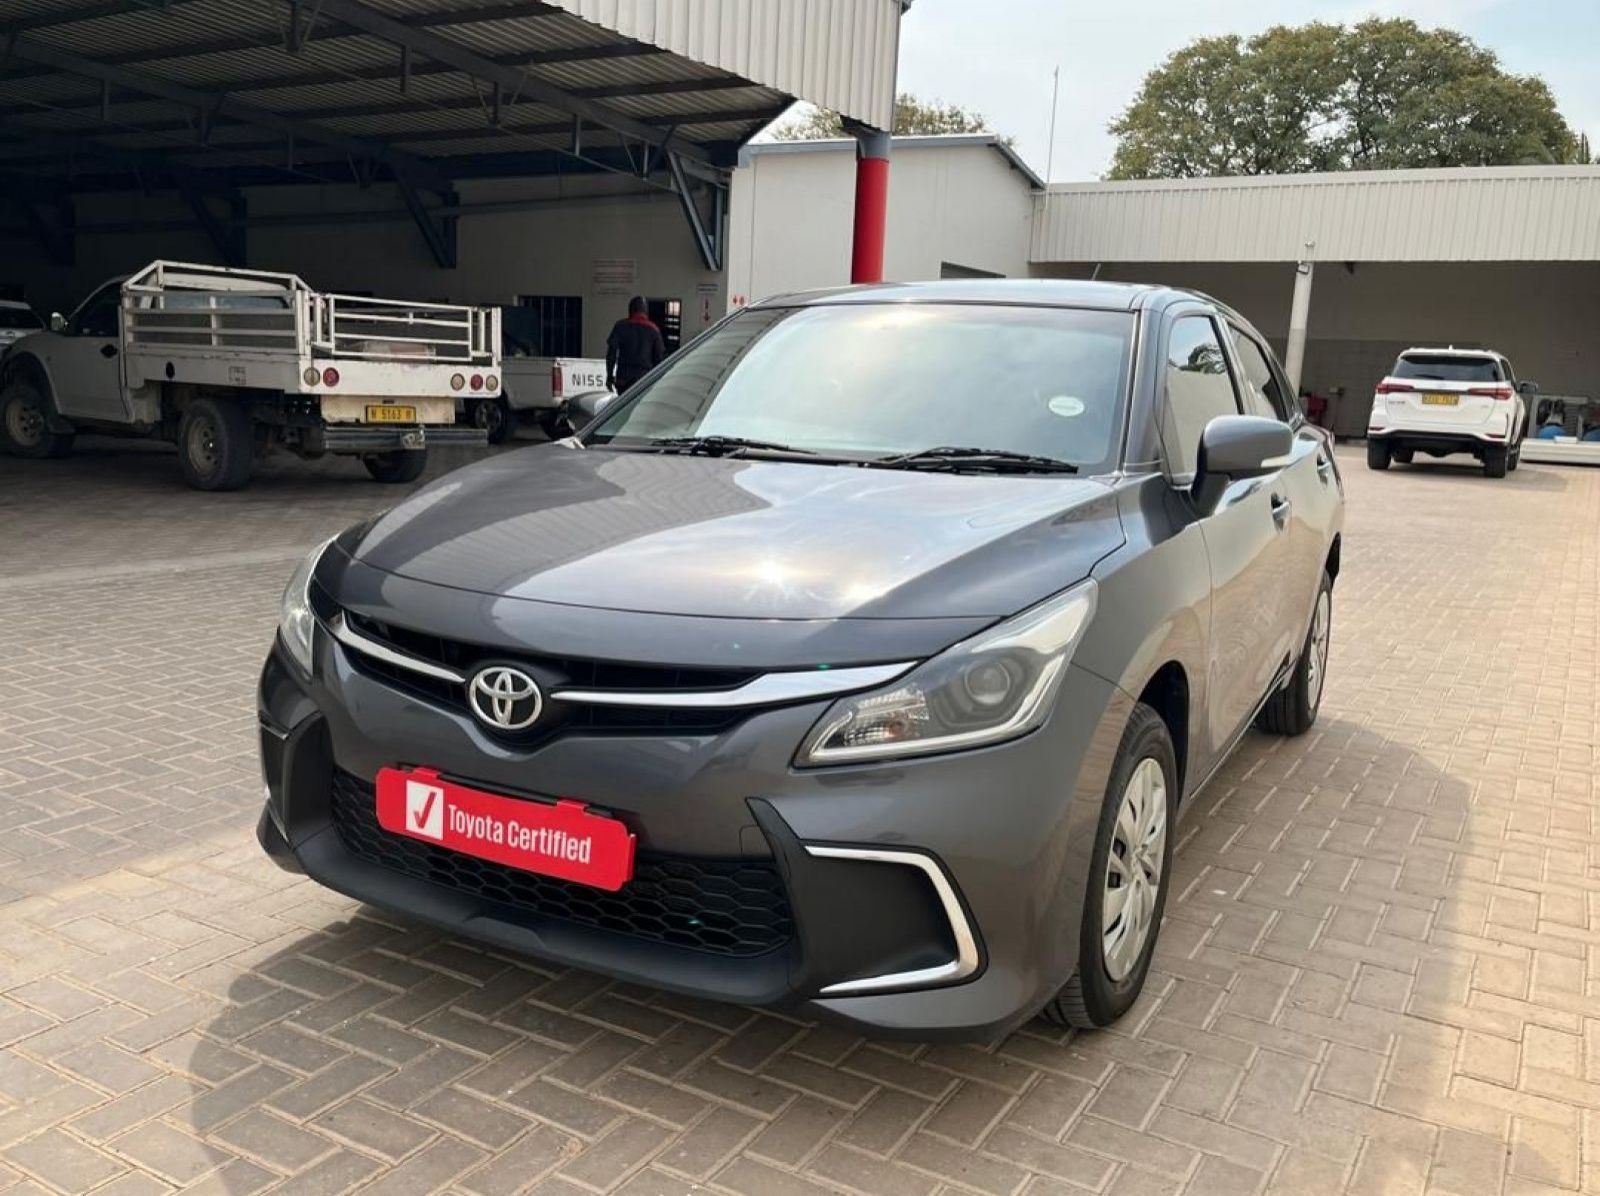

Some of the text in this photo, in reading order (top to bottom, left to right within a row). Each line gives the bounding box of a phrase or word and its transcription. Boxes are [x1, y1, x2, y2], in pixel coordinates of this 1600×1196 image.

[572, 373, 604, 387] NISS
[448, 805, 592, 864] Toyota Certified
